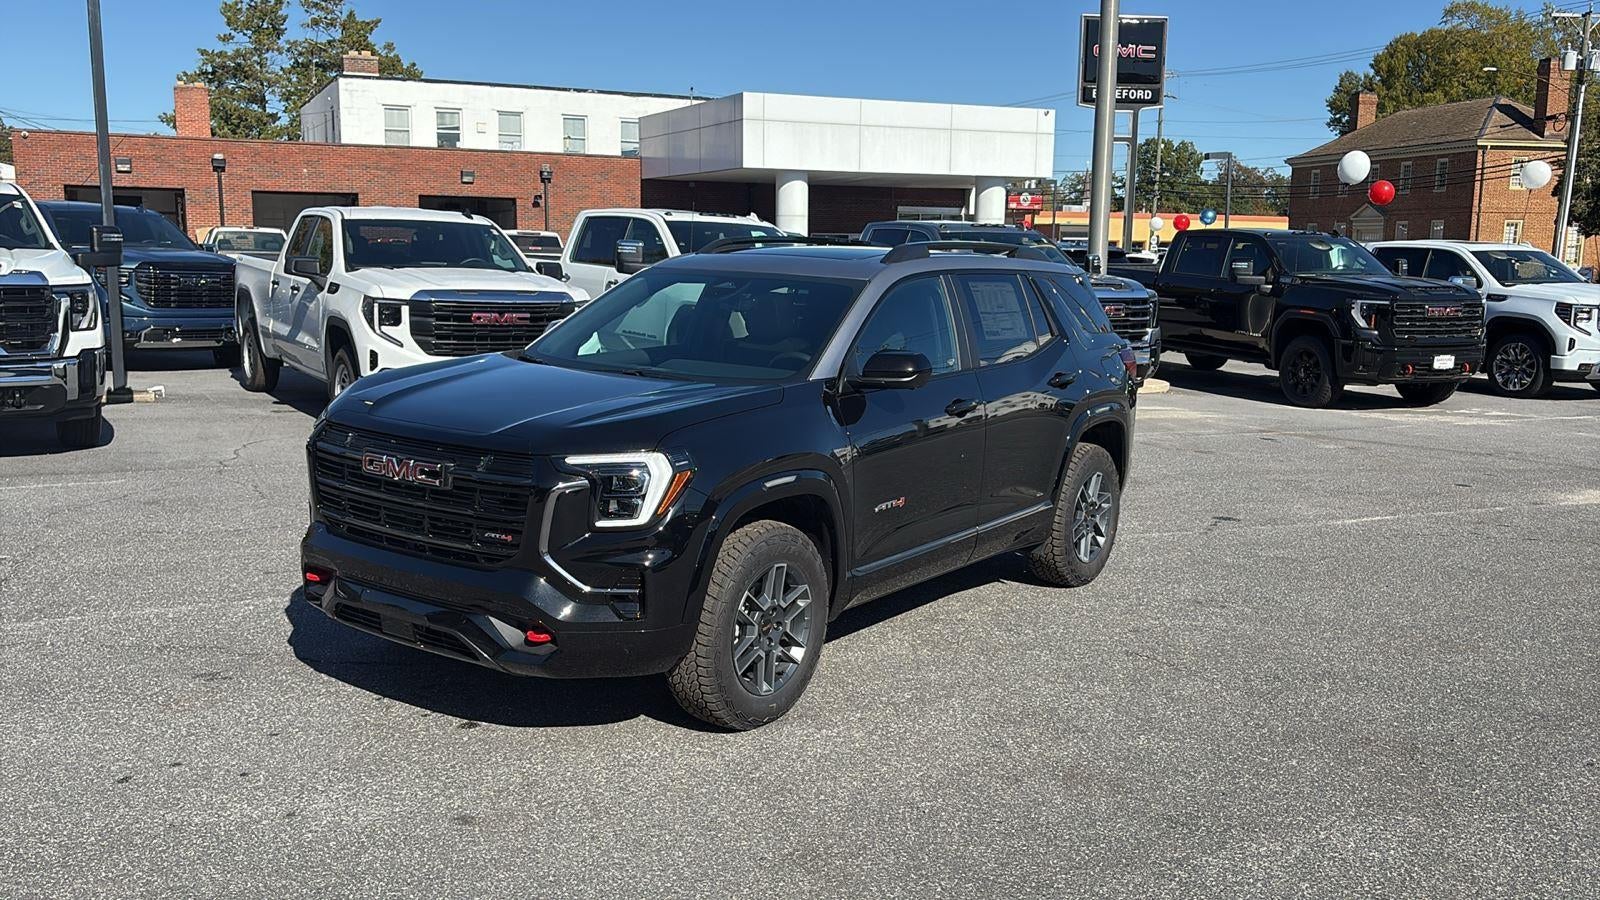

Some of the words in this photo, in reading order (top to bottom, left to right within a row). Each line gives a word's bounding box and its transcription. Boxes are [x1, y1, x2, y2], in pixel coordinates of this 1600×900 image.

[1093, 44, 1156, 58] MC
[1427, 306, 1461, 317] GMC
[471, 312, 530, 325] GMC
[362, 453, 441, 486] GMC
[874, 496, 905, 512] AT4
[484, 532, 513, 542] AT4
